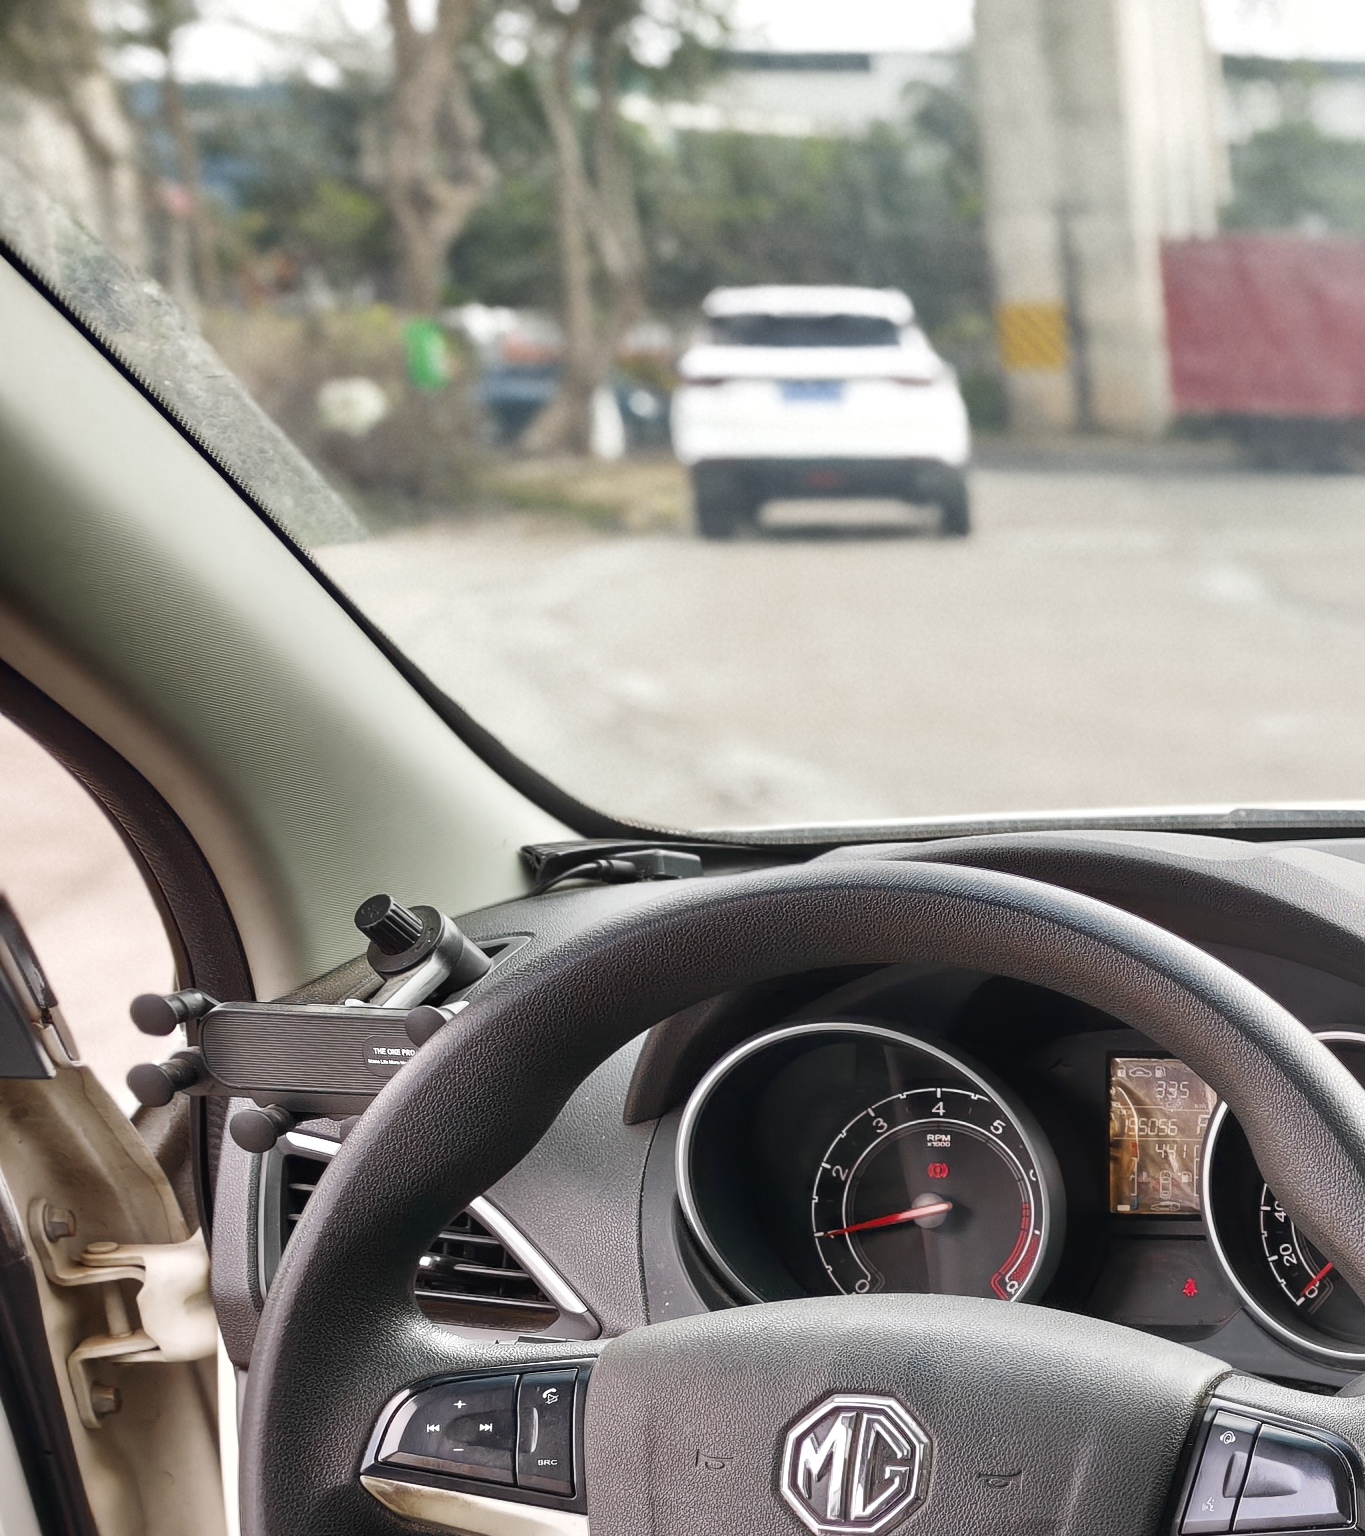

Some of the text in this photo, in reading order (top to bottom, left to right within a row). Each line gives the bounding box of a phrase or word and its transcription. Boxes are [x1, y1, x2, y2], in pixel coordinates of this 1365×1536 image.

[372, 1047, 387, 1055] THE
[1156, 1081, 1190, 1099] 335
[931, 1101, 946, 1116] 4
[872, 1118, 888, 1133] 3
[990, 1119, 1006, 1134] 5
[926, 1134, 951, 1142] RPM
[832, 1165, 848, 1181] 2
[1279, 1243, 1298, 1267] 20
[797, 1412, 913, 1522] MG
